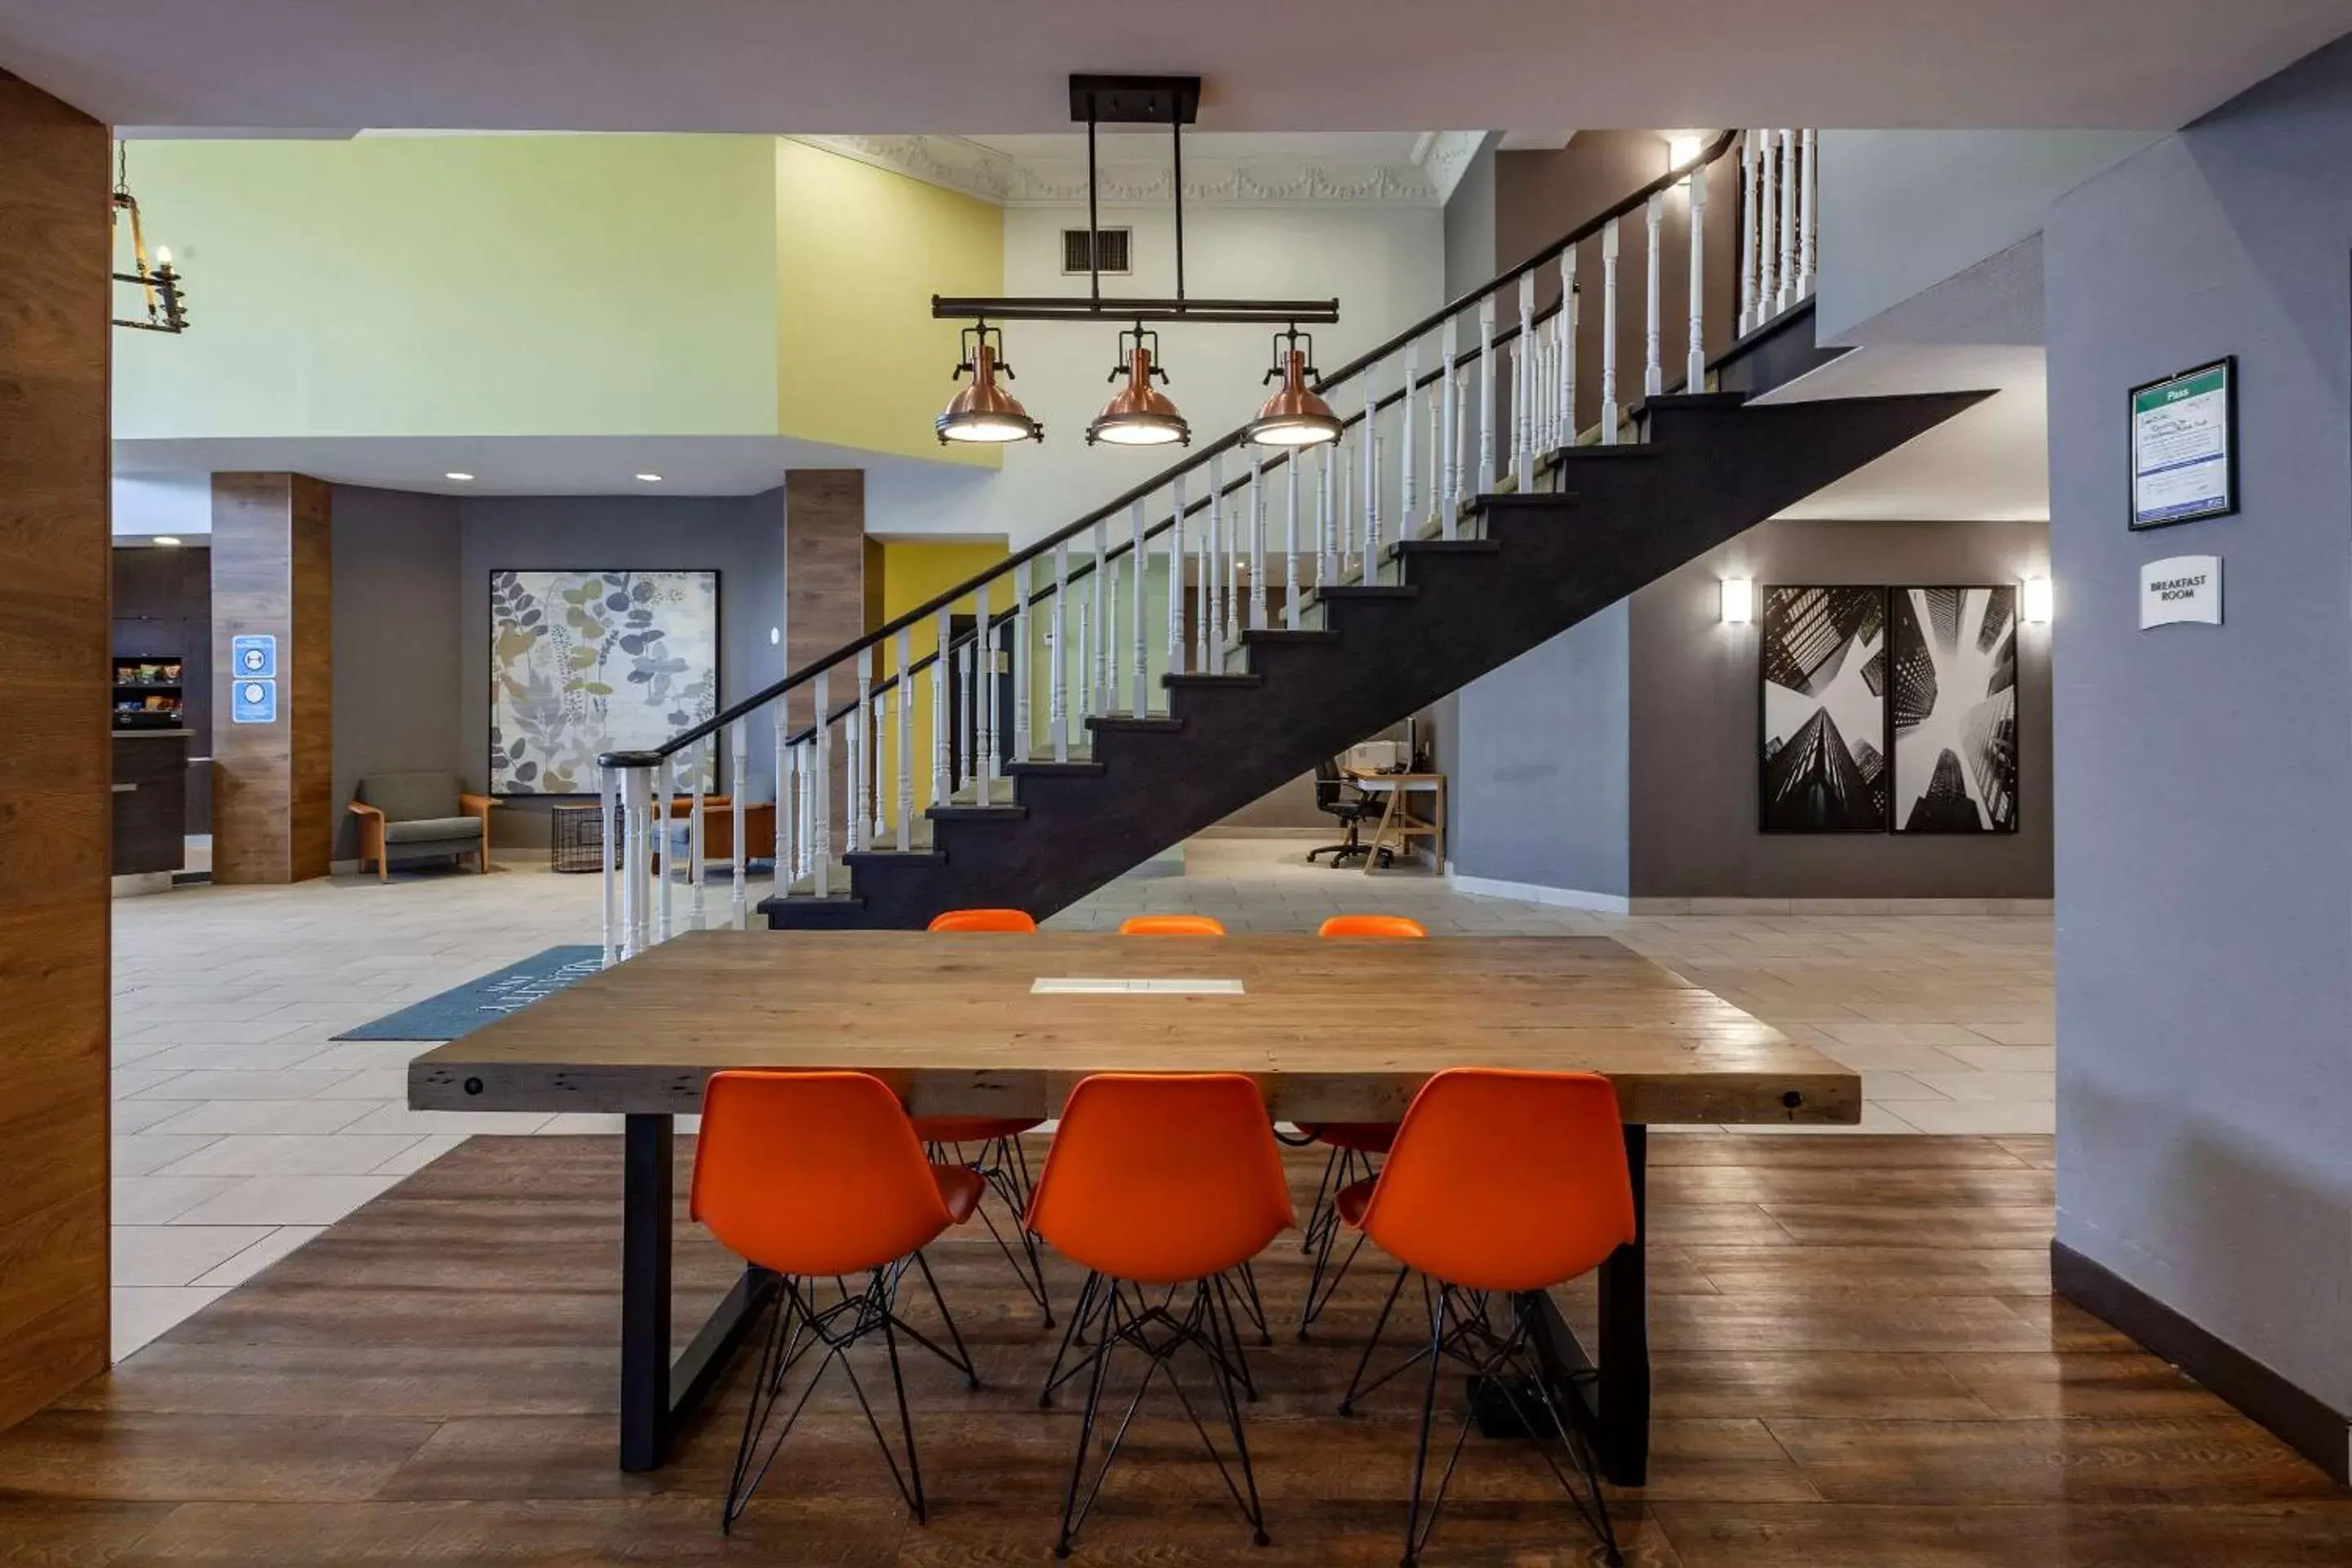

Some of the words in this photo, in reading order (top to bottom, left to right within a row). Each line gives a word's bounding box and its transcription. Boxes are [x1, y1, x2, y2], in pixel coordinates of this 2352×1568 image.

[2167, 389, 2189, 401] Pass
[2150, 575, 2207, 592] BREAKFAST
[2162, 589, 2194, 601] ROOM
